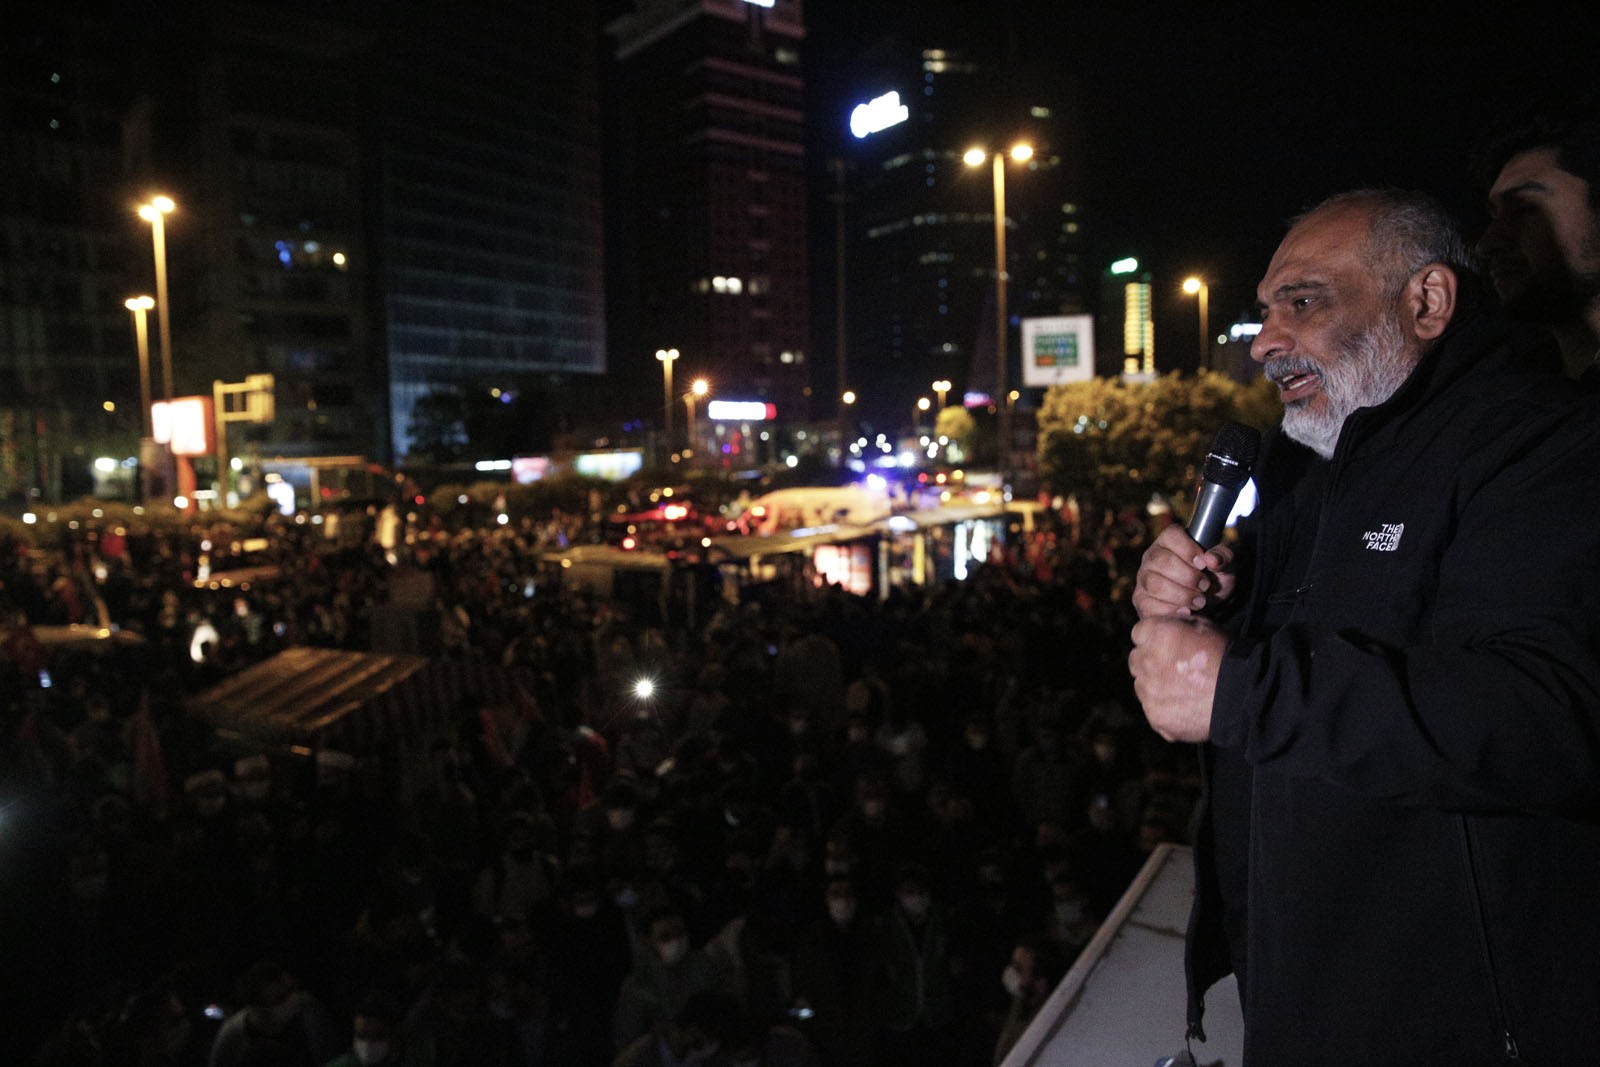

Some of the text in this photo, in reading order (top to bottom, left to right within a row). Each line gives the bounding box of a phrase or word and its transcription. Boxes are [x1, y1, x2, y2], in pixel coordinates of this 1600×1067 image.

[1382, 524, 1400, 533] THE
[1362, 531, 1397, 542] NORTH
[1366, 541, 1393, 551] FACE
